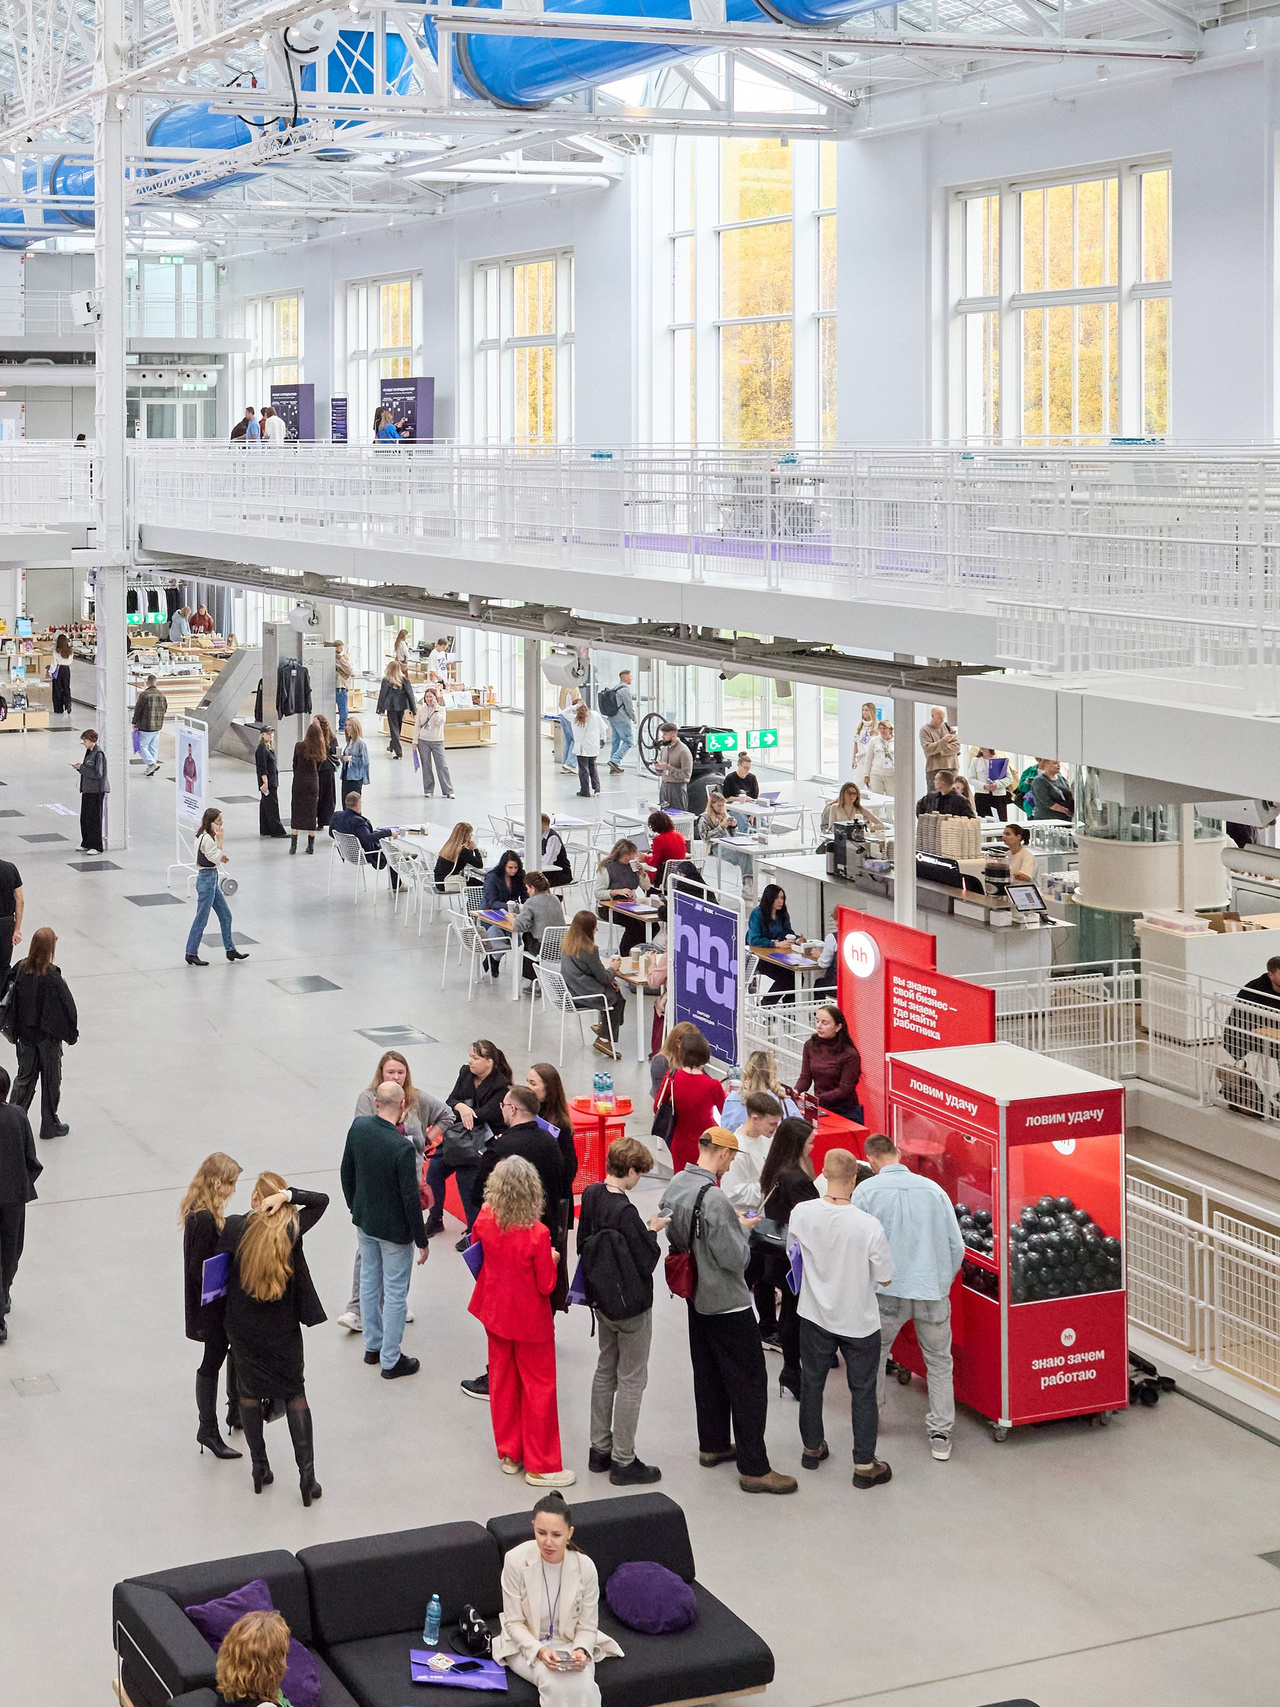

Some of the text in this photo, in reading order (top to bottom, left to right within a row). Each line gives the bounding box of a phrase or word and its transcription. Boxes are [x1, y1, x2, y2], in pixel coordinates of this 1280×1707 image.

[851, 945, 868, 964] hh
[686, 961, 736, 1010] ru
[893, 976, 937, 997] вы знаете
[893, 986, 915, 1001] свой
[916, 992, 948, 1011] бизнес
[893, 997, 938, 1020] мы знаем,
[893, 1006, 936, 1028] где найти
[893, 1017, 941, 1041] работника
[909, 1078, 978, 1117] ловим удачу
[1025, 1108, 1104, 1127] ловим удачу
[1031, 1349, 1105, 1370] знаю зачем
[1040, 1369, 1097, 1390] работаю
